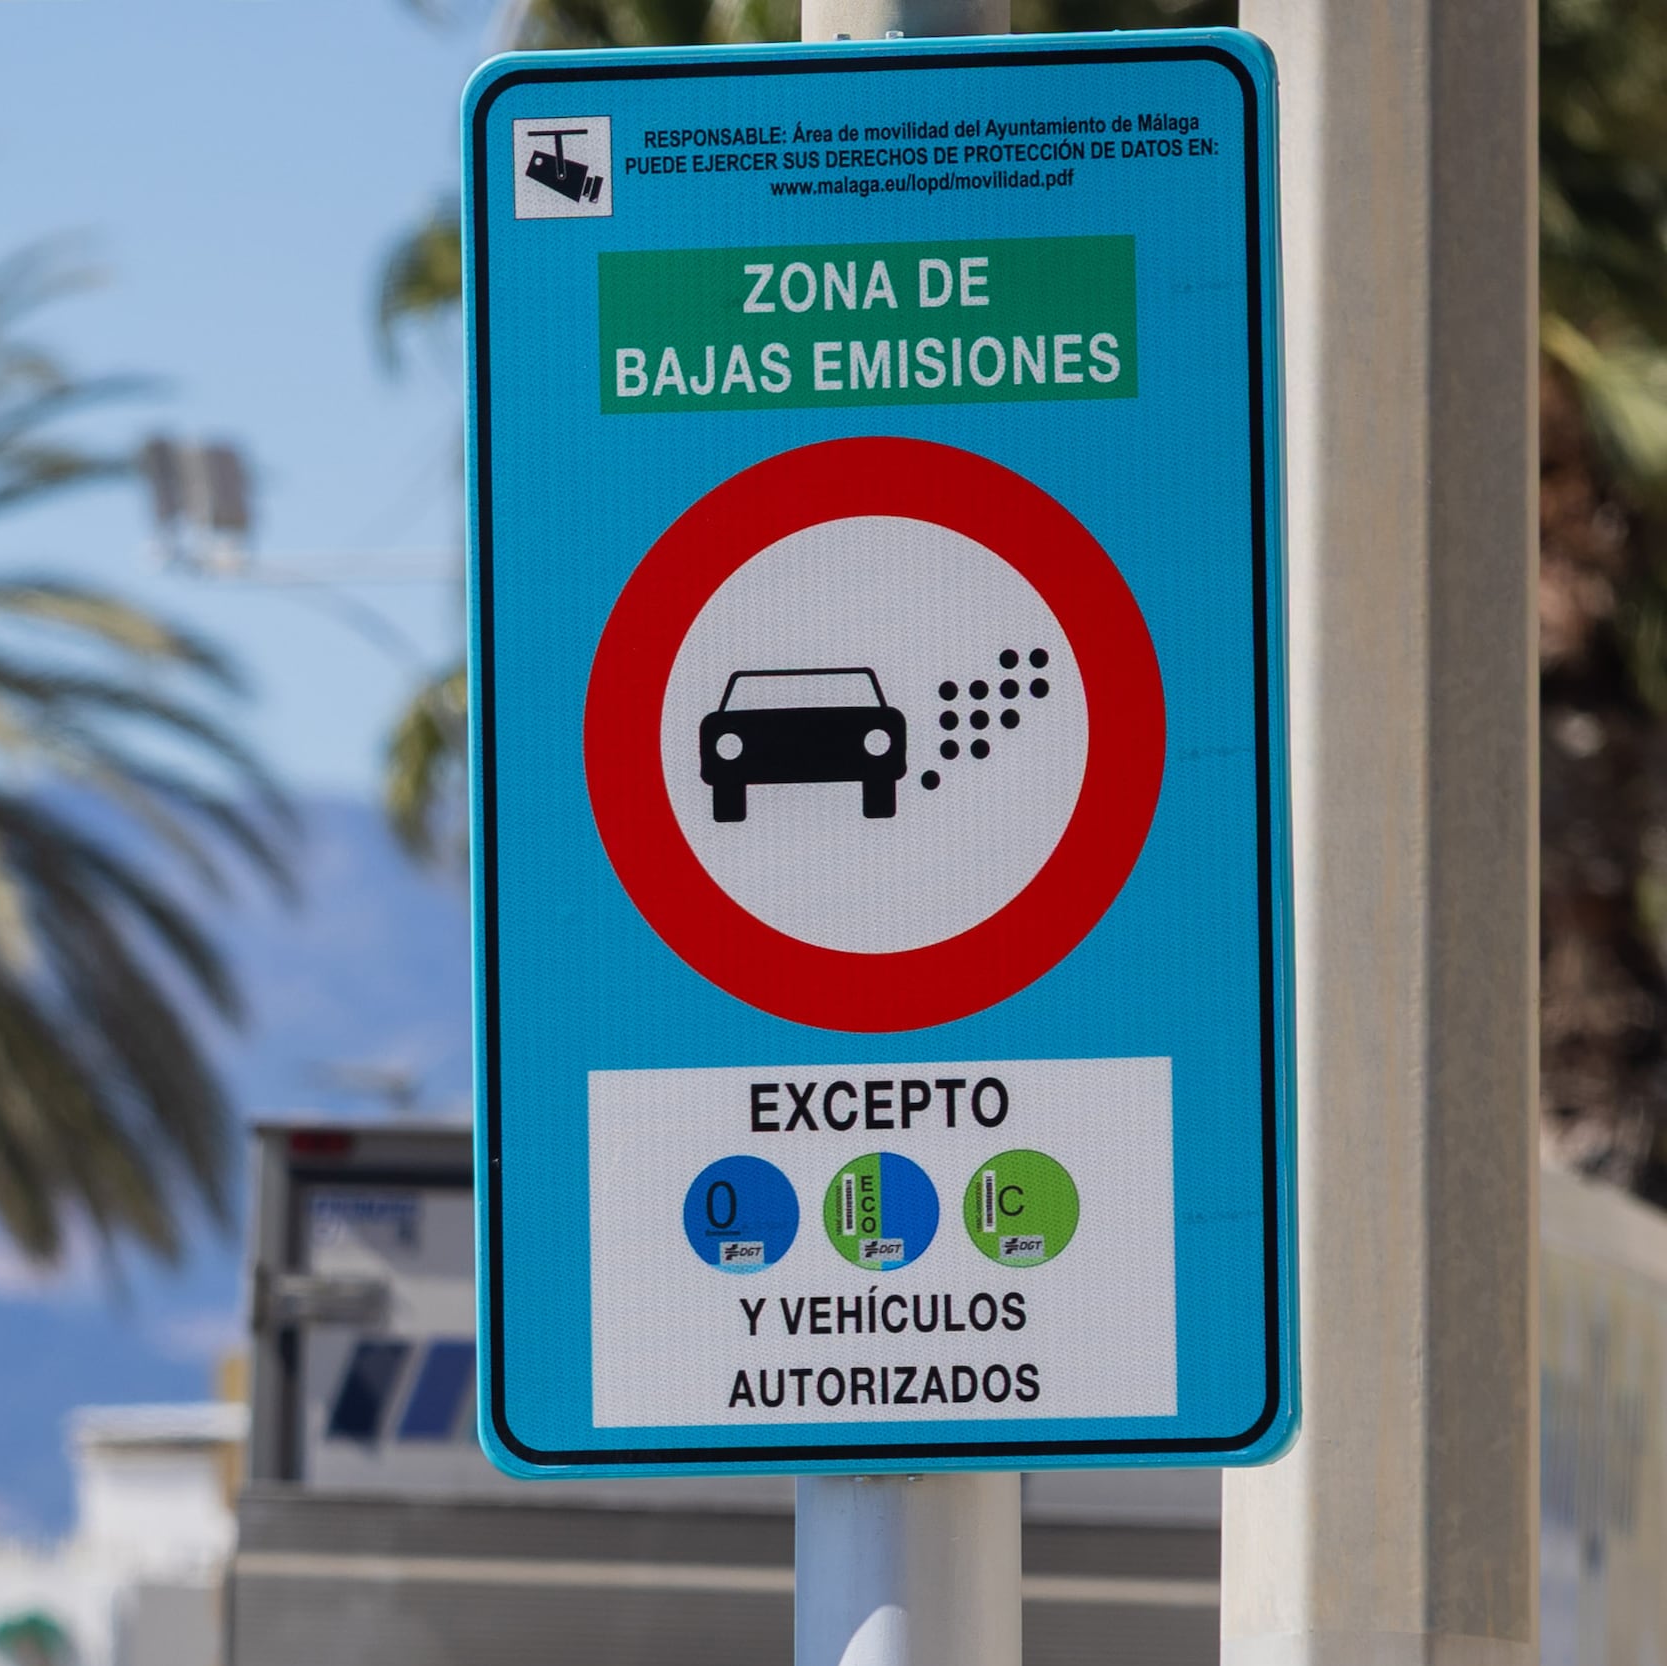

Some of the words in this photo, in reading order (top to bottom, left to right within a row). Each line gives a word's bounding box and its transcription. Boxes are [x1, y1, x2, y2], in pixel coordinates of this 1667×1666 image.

[644, 126, 787, 148] RESPONSABLE:
[792, 121, 833, 143] Área
[838, 124, 859, 142] de
[864, 121, 949, 141] movilidad
[954, 120, 980, 138] del
[985, 116, 1106, 141] Ayuntamiento
[1112, 115, 1132, 133] de
[1138, 113, 1200, 135] Málaga
[626, 155, 687, 175] PUEDE
[693, 152, 778, 173] EJERCER
[783, 150, 820, 170] SUS
[826, 147, 928, 169] DERECHOS
[934, 146, 958, 165] DE
[964, 139, 1085, 163] PROTECCIÓN
[1091, 141, 1115, 160] DE
[1122, 139, 1183, 159] DATOS
[1189, 138, 1219, 156] EN:
[771, 168, 1074, 197] www.malaga.eu/lopd/movilidad.pdf
[743, 260, 898, 313] ZONA
[918, 256, 990, 308] DE
[616, 342, 792, 397] BAJAS
[813, 332, 1121, 391] EMISIONES
[750, 1077, 1009, 1132] EXCEPTO
[706, 1181, 737, 1229] 0
[861, 1175, 877, 1233] ECO
[998, 1185, 1024, 1217] C
[740, 1246, 762, 1257] DGT
[878, 1244, 901, 1254] DGT
[1019, 1240, 1042, 1251] DGT
[740, 1298, 766, 1336] Y
[780, 1285, 1027, 1335] VEHÍCULOS
[728, 1363, 1040, 1408] AUTORIZADOS
